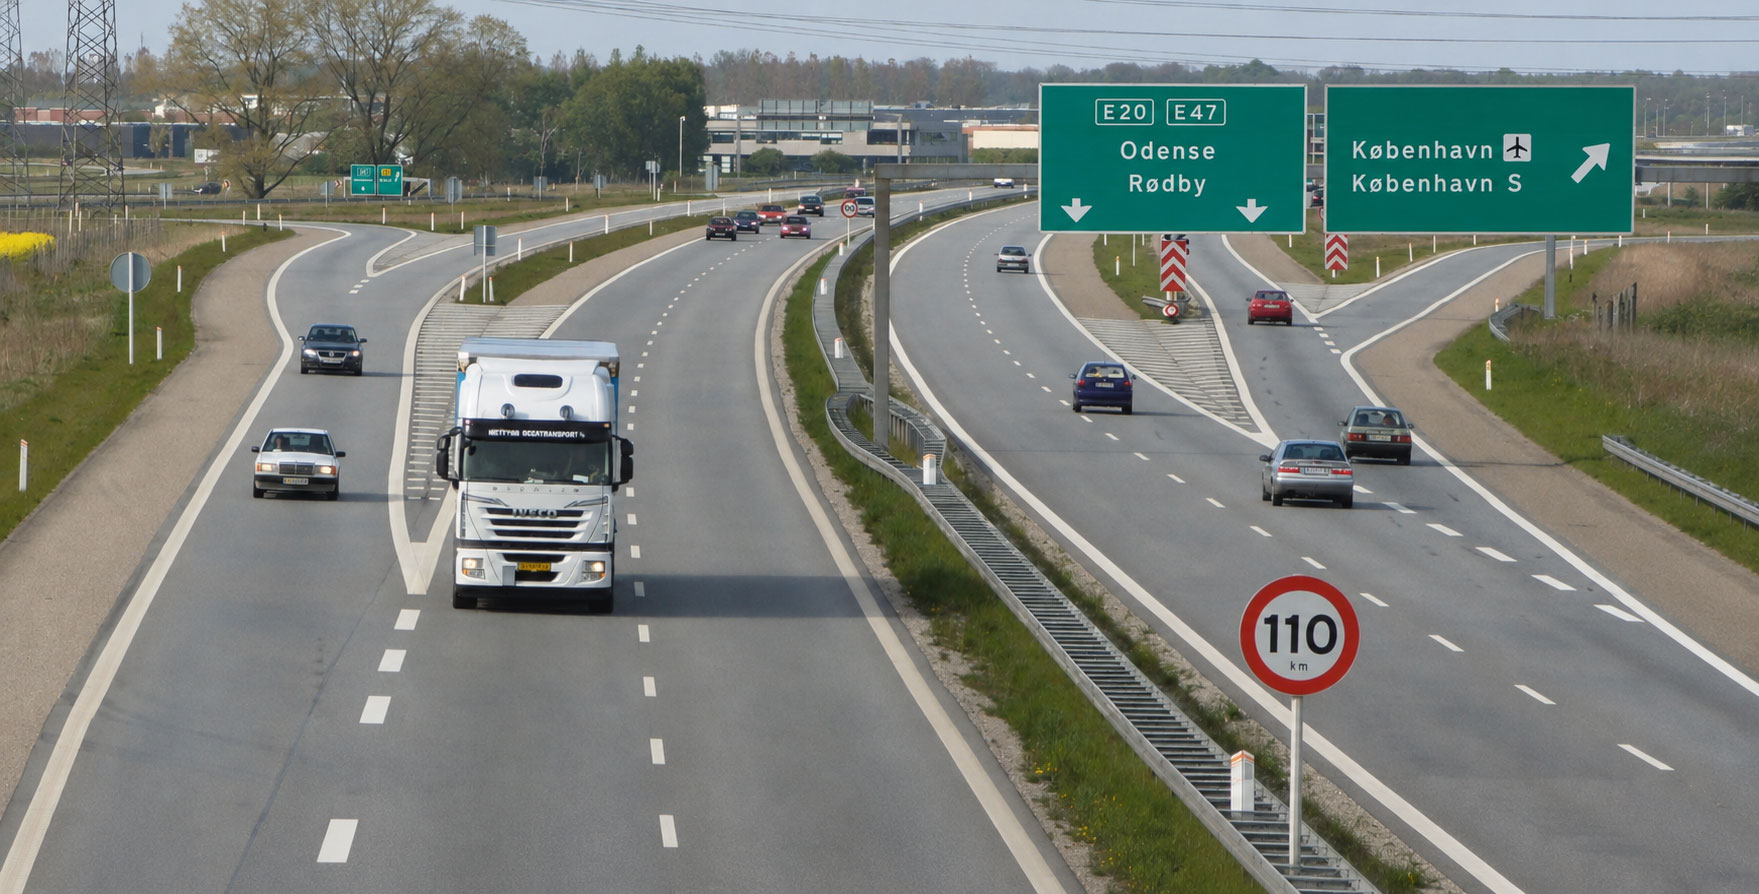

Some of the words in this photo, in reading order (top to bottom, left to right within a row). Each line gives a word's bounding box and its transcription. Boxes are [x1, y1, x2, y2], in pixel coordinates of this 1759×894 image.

[1103, 103, 1146, 120] E20
[1174, 104, 1217, 121] E47
[1120, 140, 1216, 160] Odense
[1351, 139, 1494, 160] København
[1129, 173, 1206, 198] Rødby
[1351, 173, 1494, 193] København
[1507, 173, 1522, 193] S
[1263, 613, 1338, 655] 110
[1290, 660, 1308, 671] km
